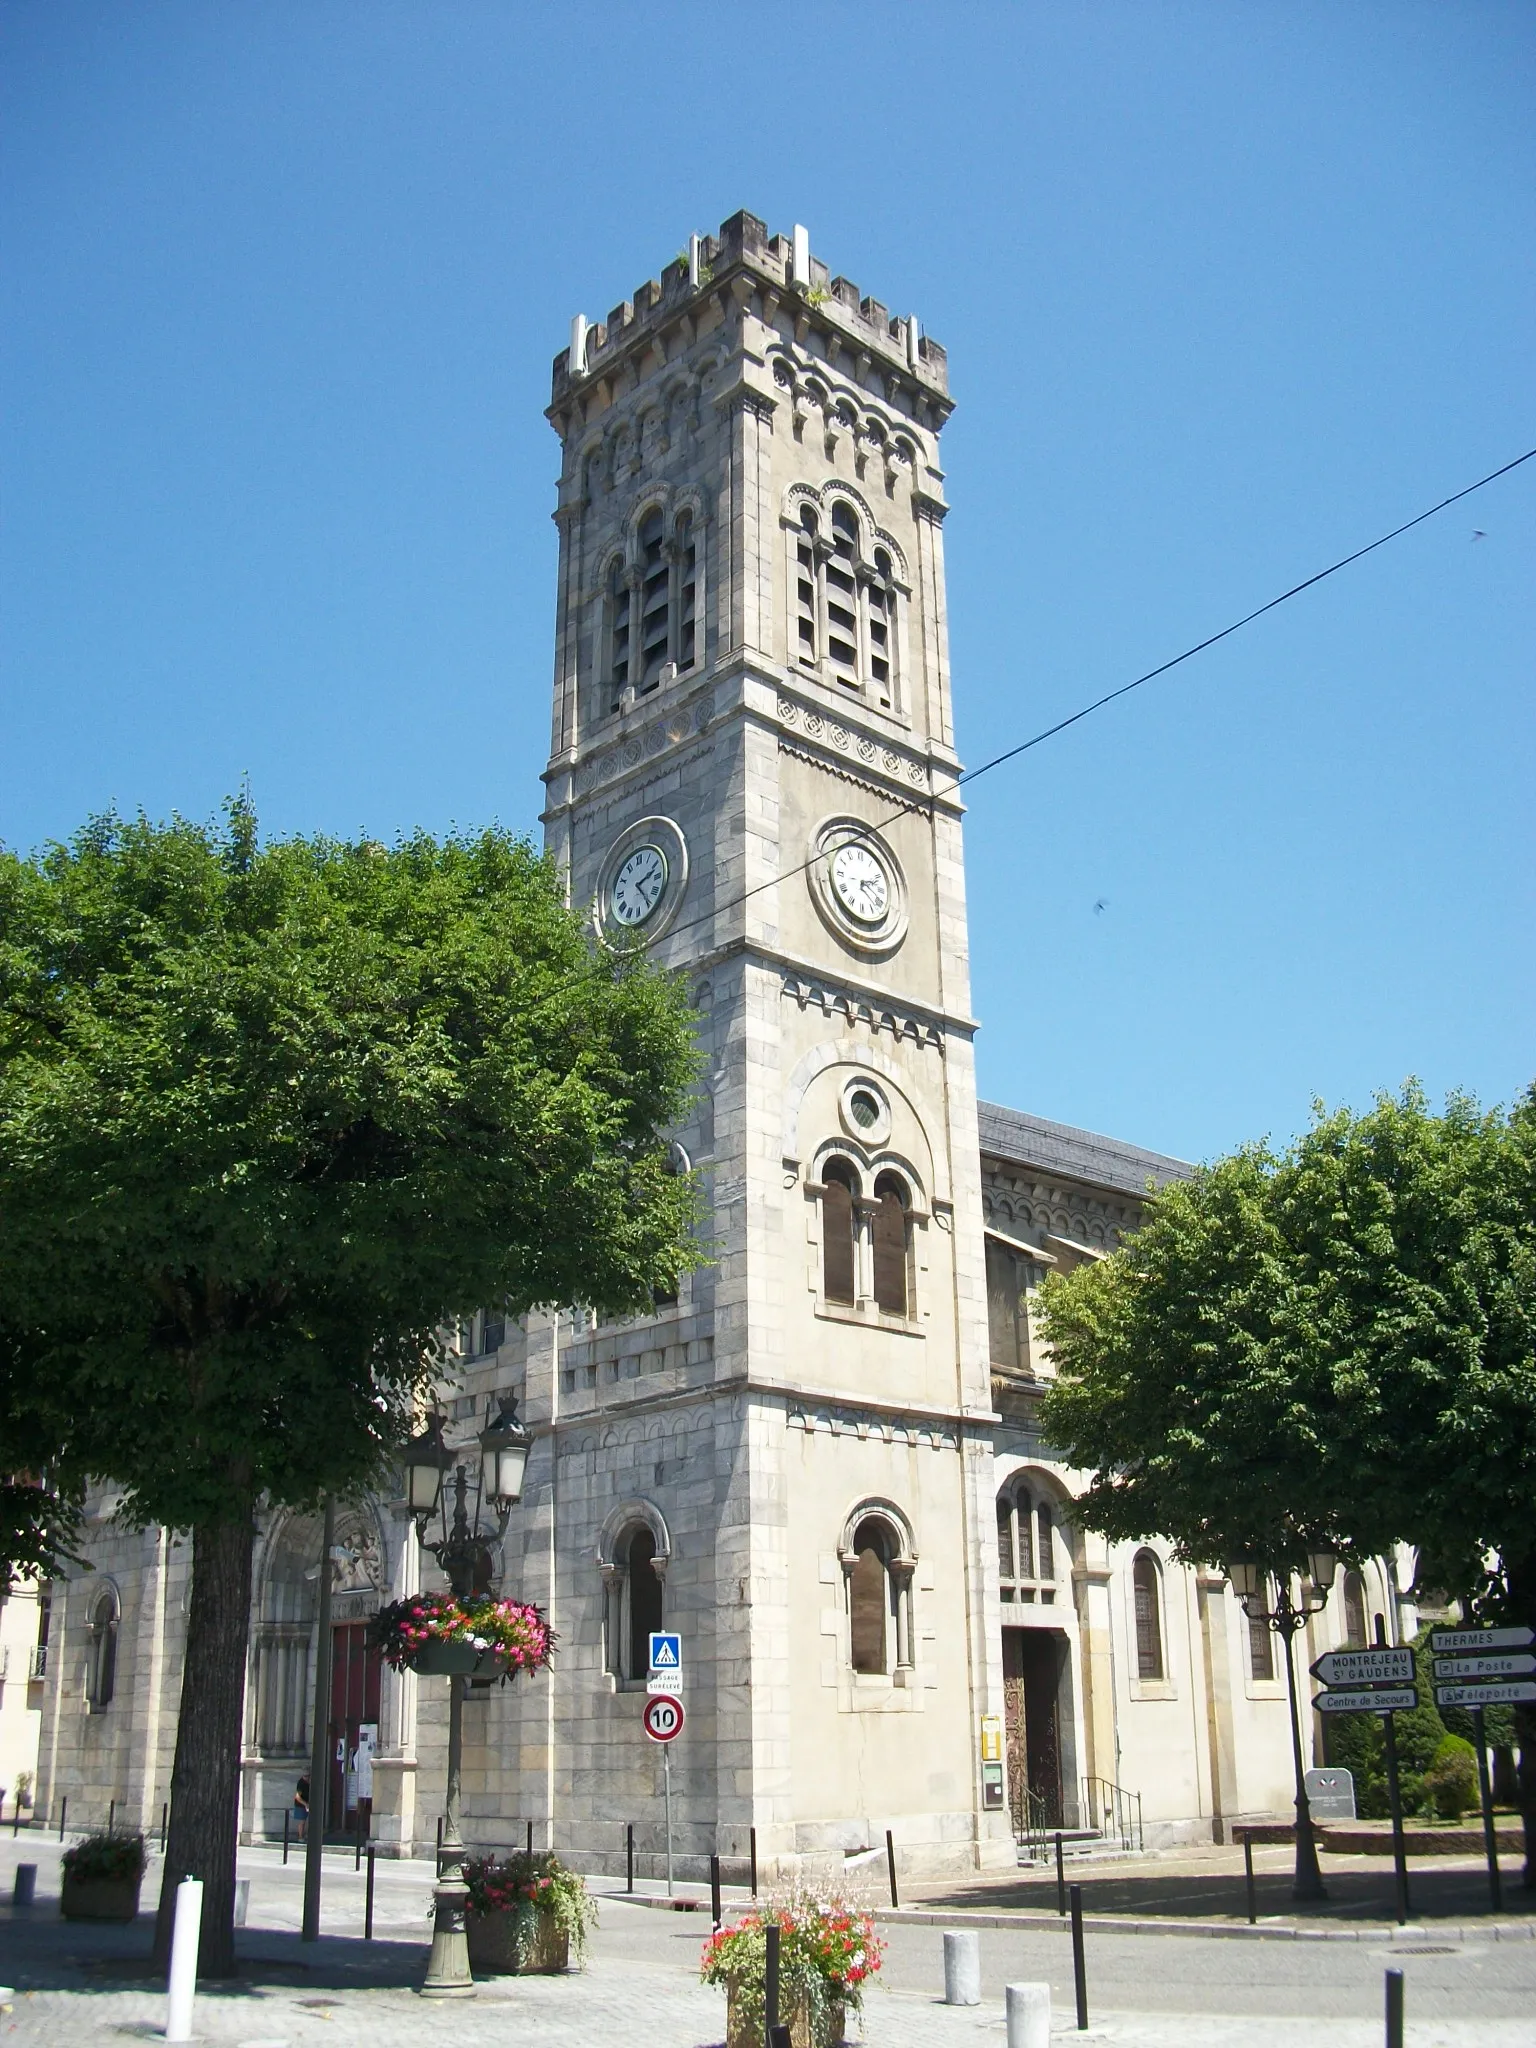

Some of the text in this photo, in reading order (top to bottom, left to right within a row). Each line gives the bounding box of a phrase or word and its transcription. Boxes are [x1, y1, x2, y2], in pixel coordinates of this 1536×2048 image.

[1437, 1633, 1493, 1646] THERMES
[1332, 1653, 1407, 1667] MONTRÉJEAU
[1457, 1661, 1512, 1672] La Poste
[1349, 1666, 1408, 1679] GAUDENS
[1327, 1695, 1410, 1707] Centre de Secours
[653, 1709, 674, 1727] 10
